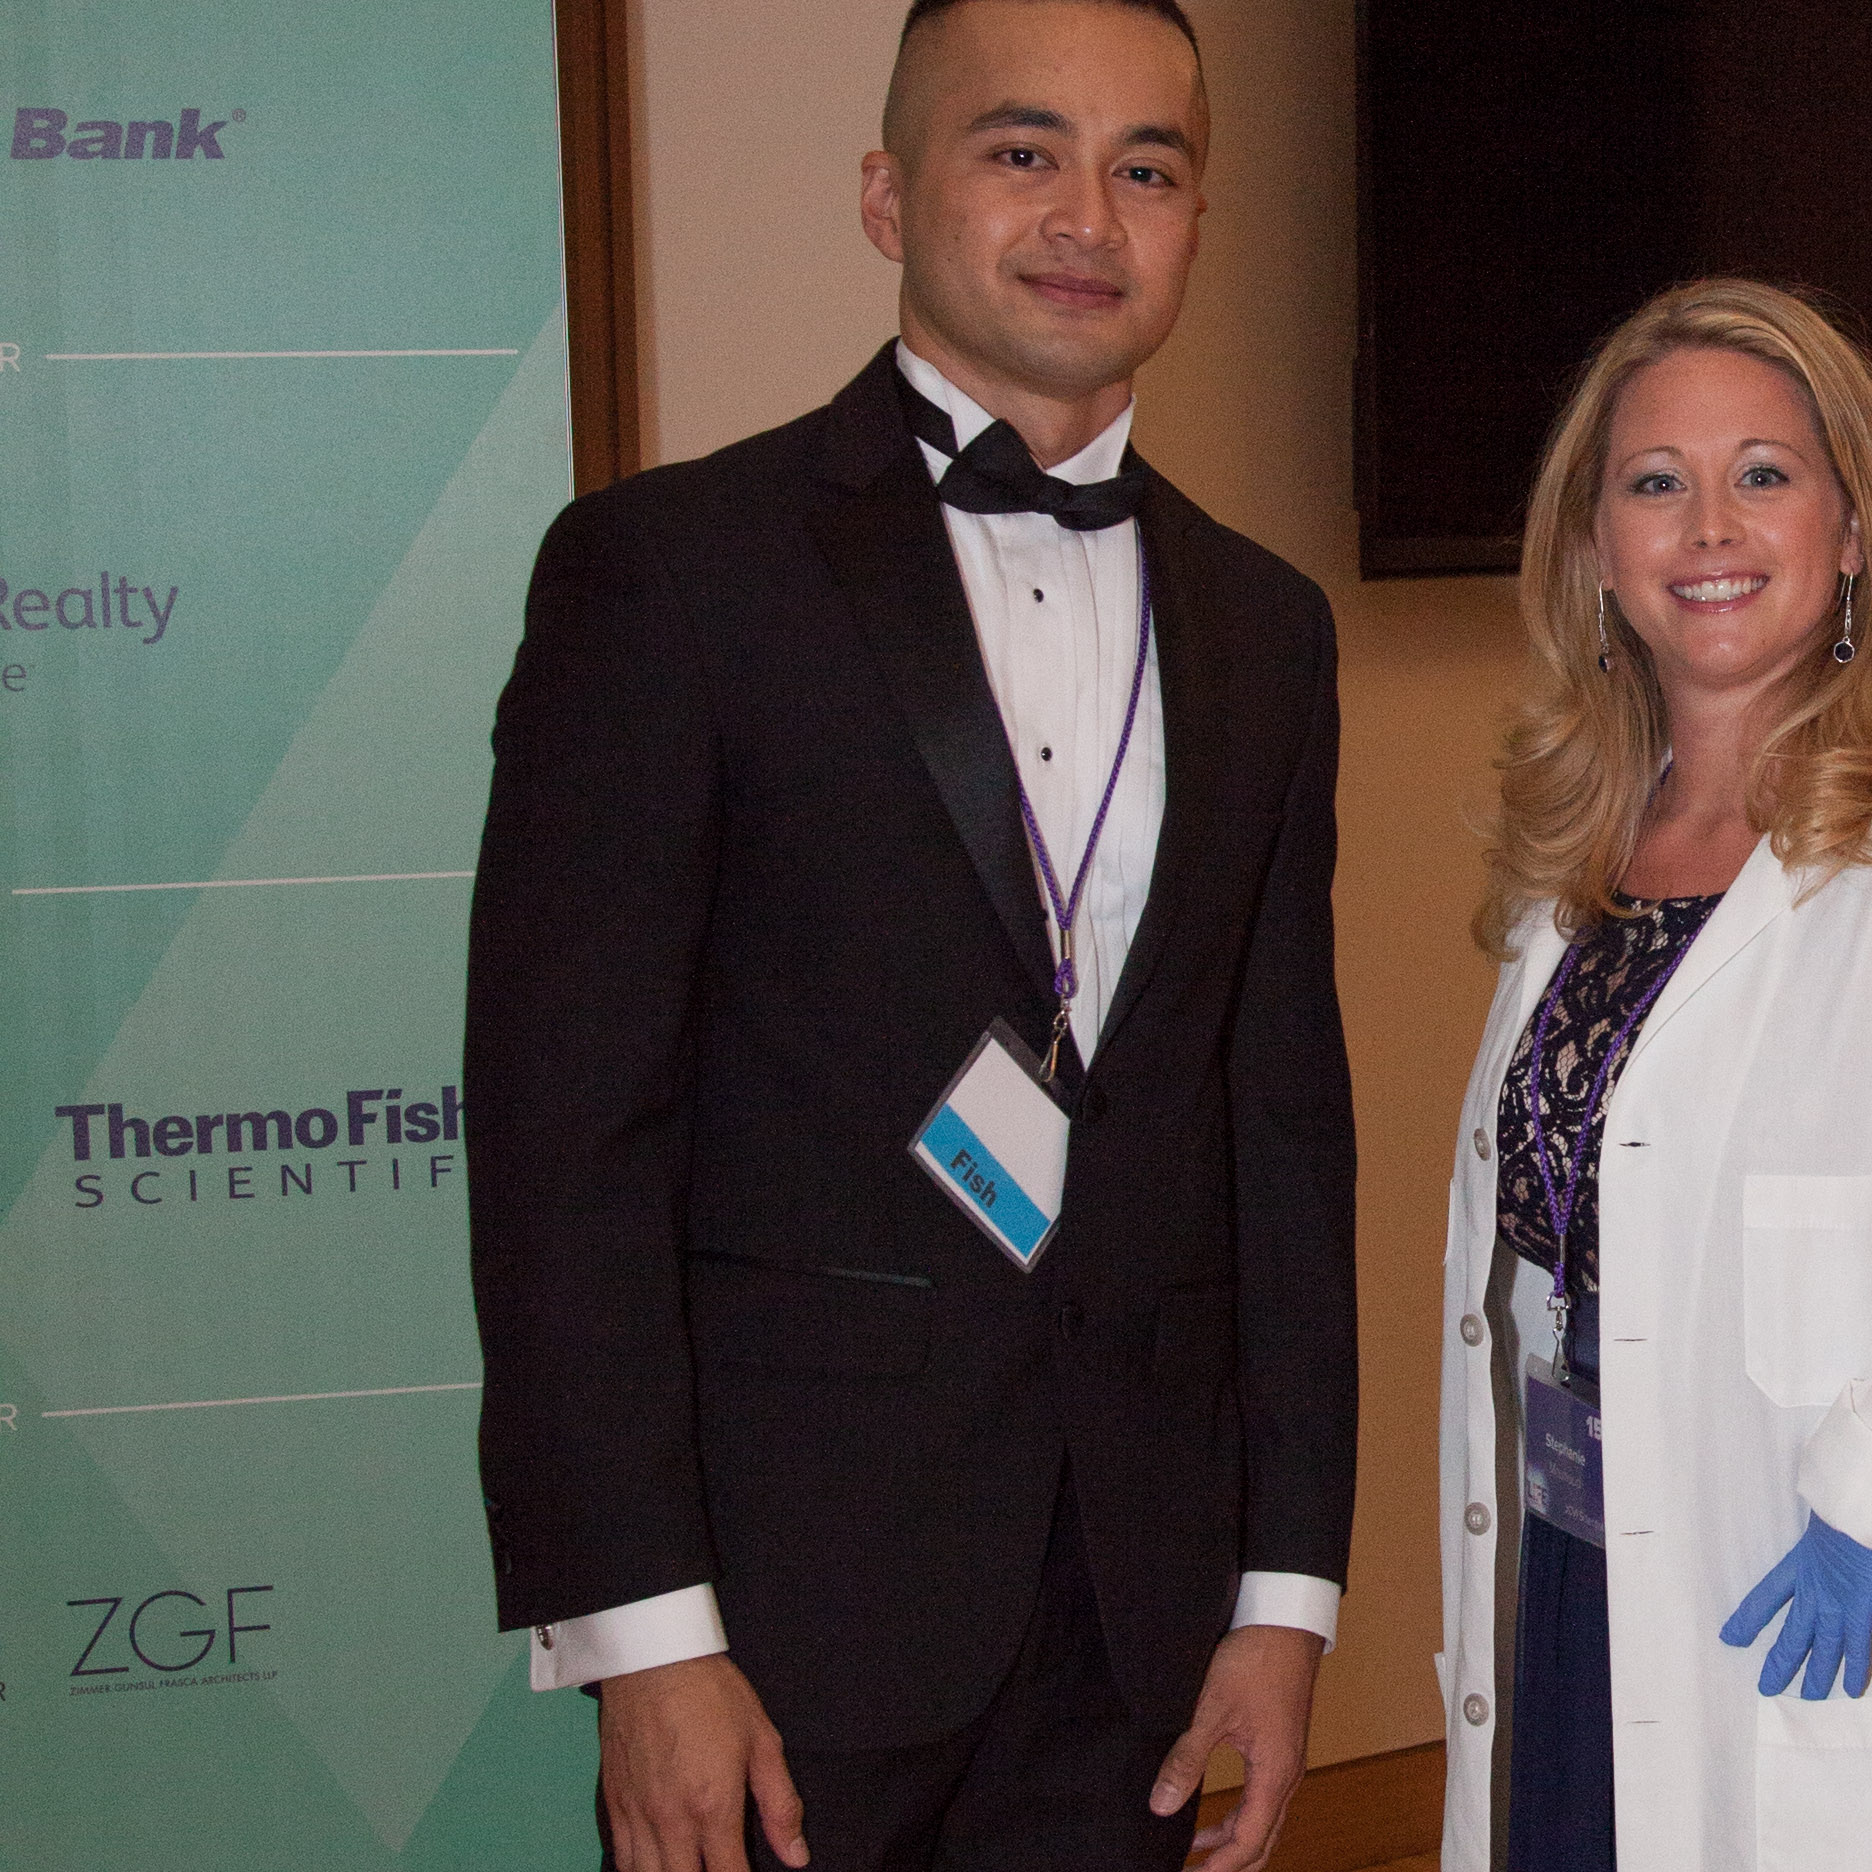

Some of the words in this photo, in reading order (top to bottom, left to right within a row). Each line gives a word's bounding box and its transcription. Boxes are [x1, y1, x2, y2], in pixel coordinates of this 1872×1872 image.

[74, 1155, 454, 1209] SCIENTIF
[950, 1148, 997, 1209] Fish
[67, 1585, 274, 1677] ZGF
